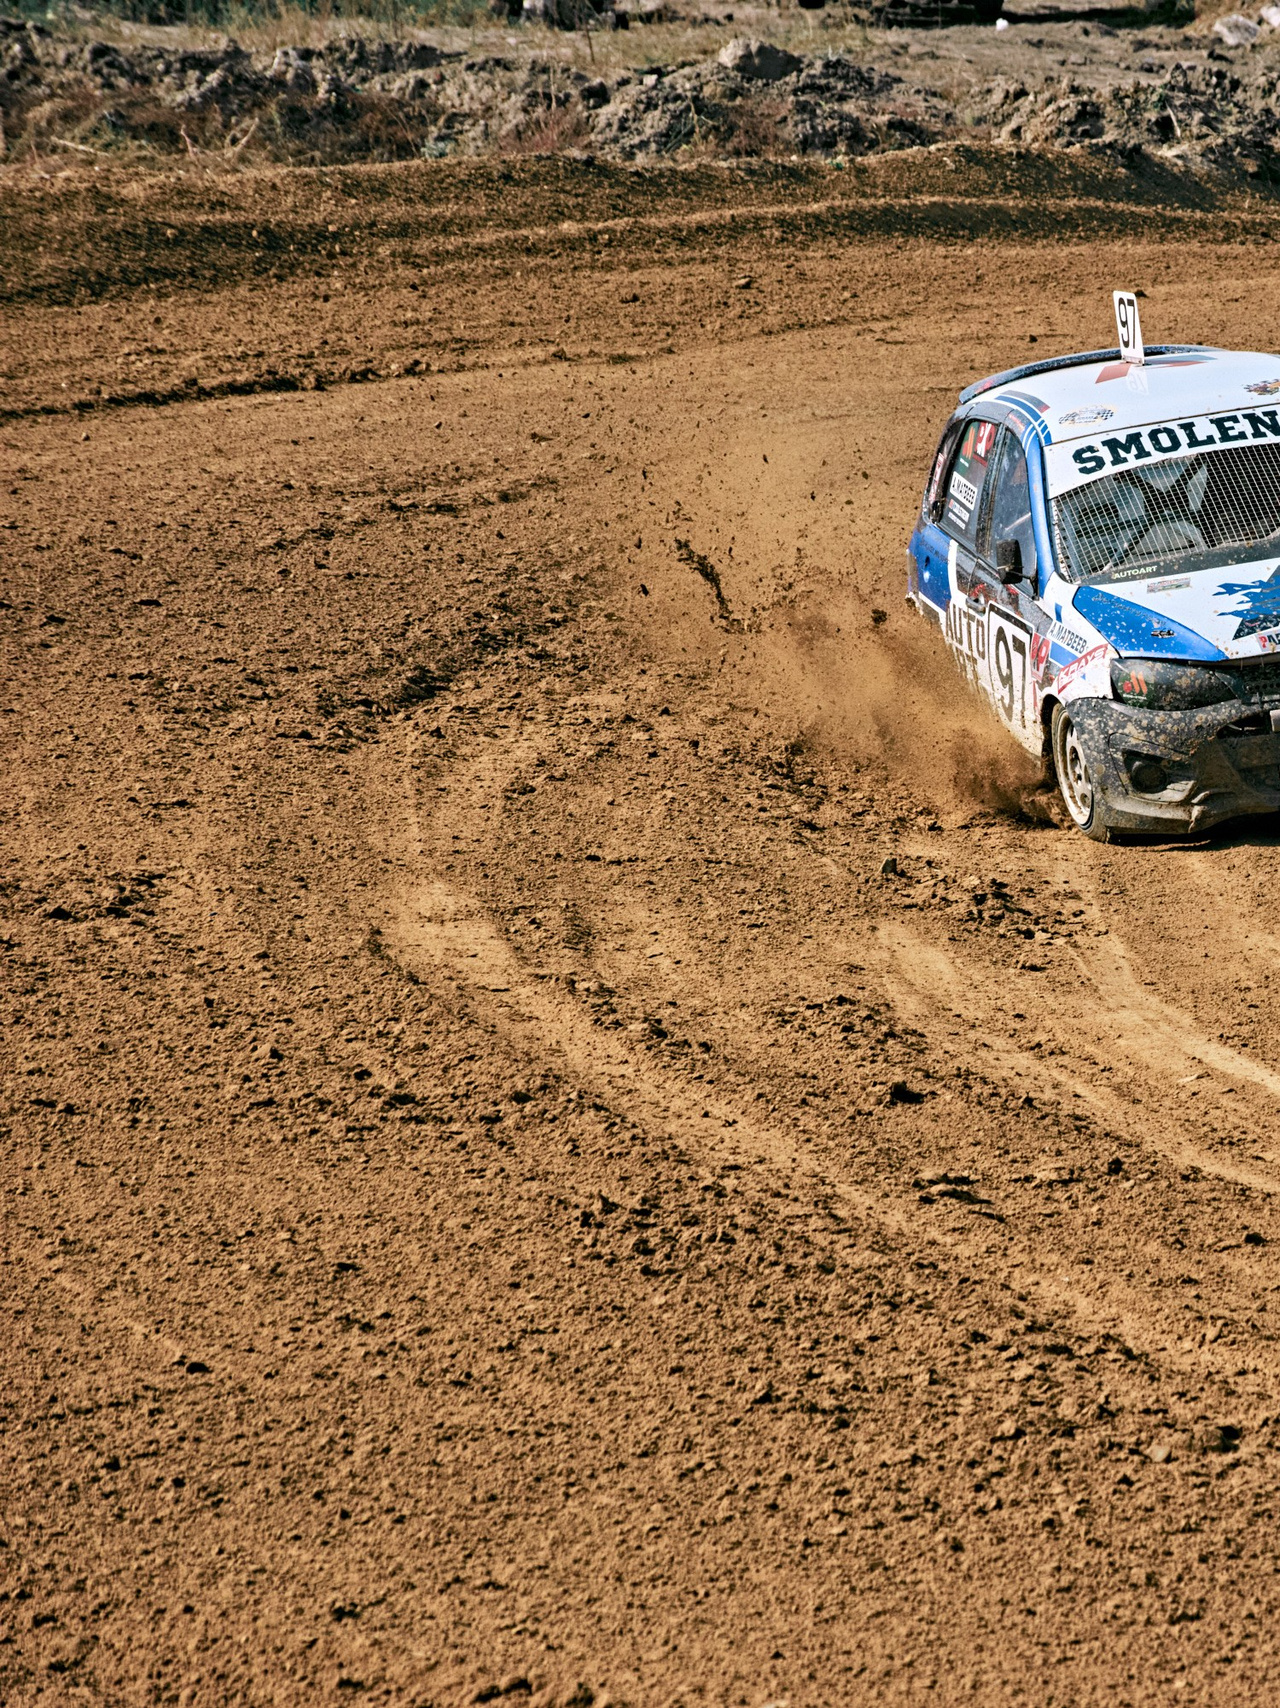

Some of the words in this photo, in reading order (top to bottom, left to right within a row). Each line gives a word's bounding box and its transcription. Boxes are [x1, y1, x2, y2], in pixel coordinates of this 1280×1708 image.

[1117, 297, 1136, 349] 97
[1114, 565, 1158, 579] AUTOART
[945, 600, 986, 660] AUTO
[995, 625, 1027, 729] 97
